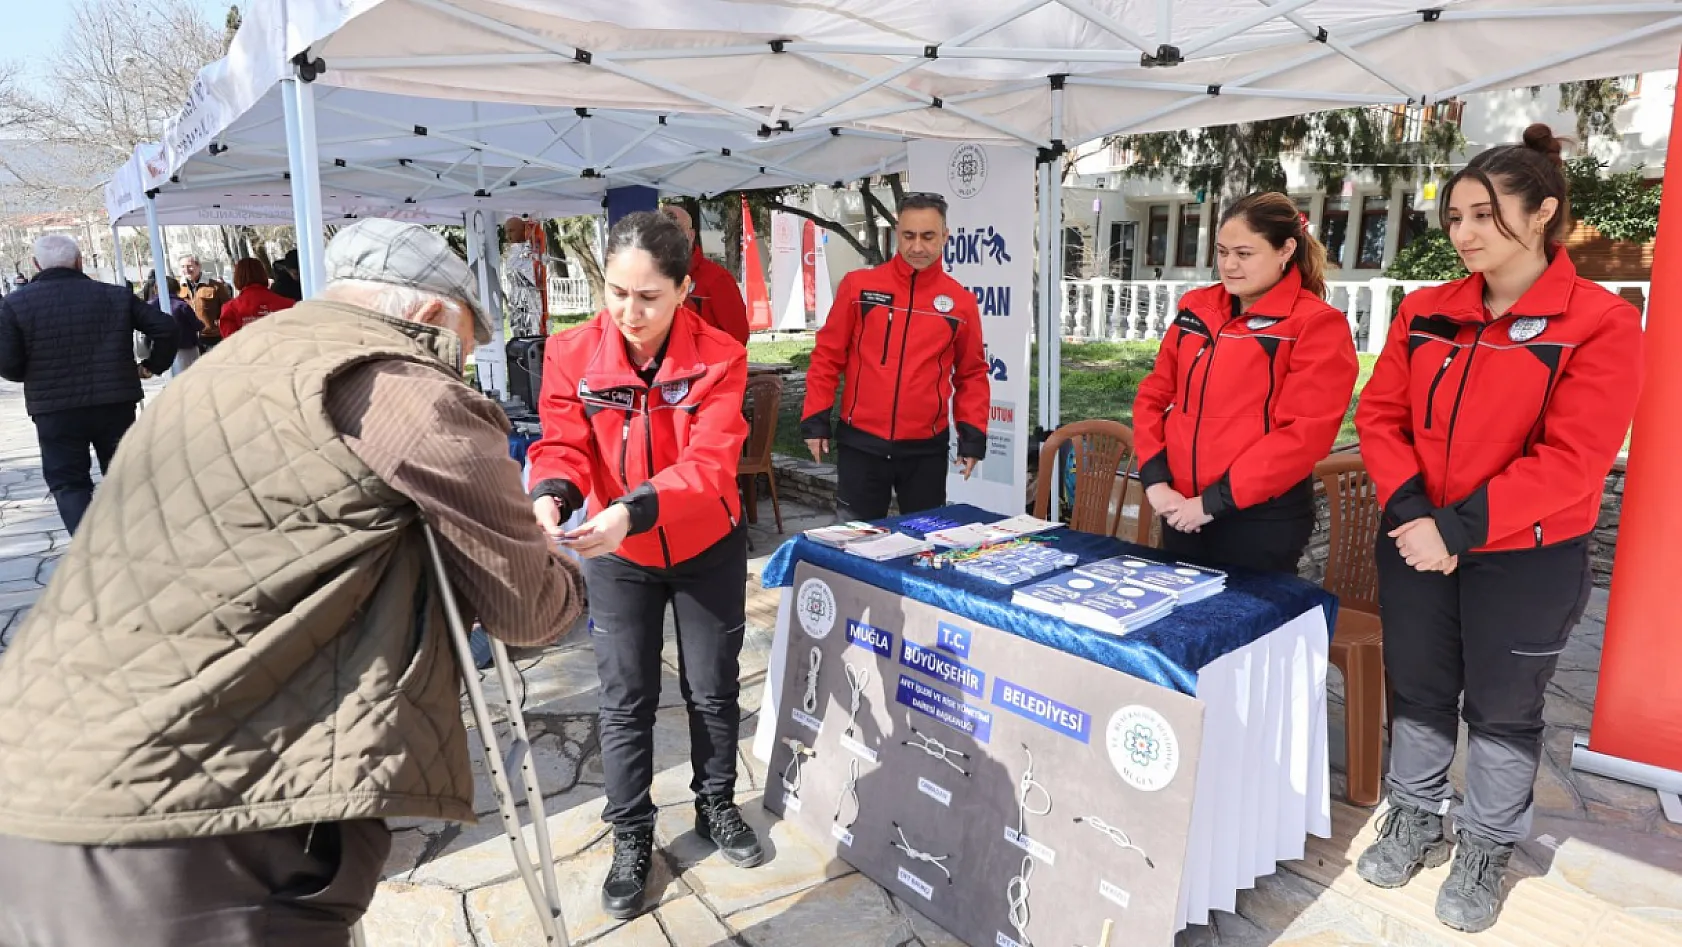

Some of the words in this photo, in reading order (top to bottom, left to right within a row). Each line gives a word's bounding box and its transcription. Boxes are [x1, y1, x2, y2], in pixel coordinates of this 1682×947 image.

[944, 227, 979, 273] ÇÖK
[963, 286, 1011, 317] PAN
[988, 405, 1013, 424] UTUN
[850, 623, 889, 651] MUĞLA
[942, 628, 965, 651] T.C.
[904, 645, 979, 691] BÜYÜKŞEHİR
[1003, 685, 1084, 733] BELEDİYESİ
